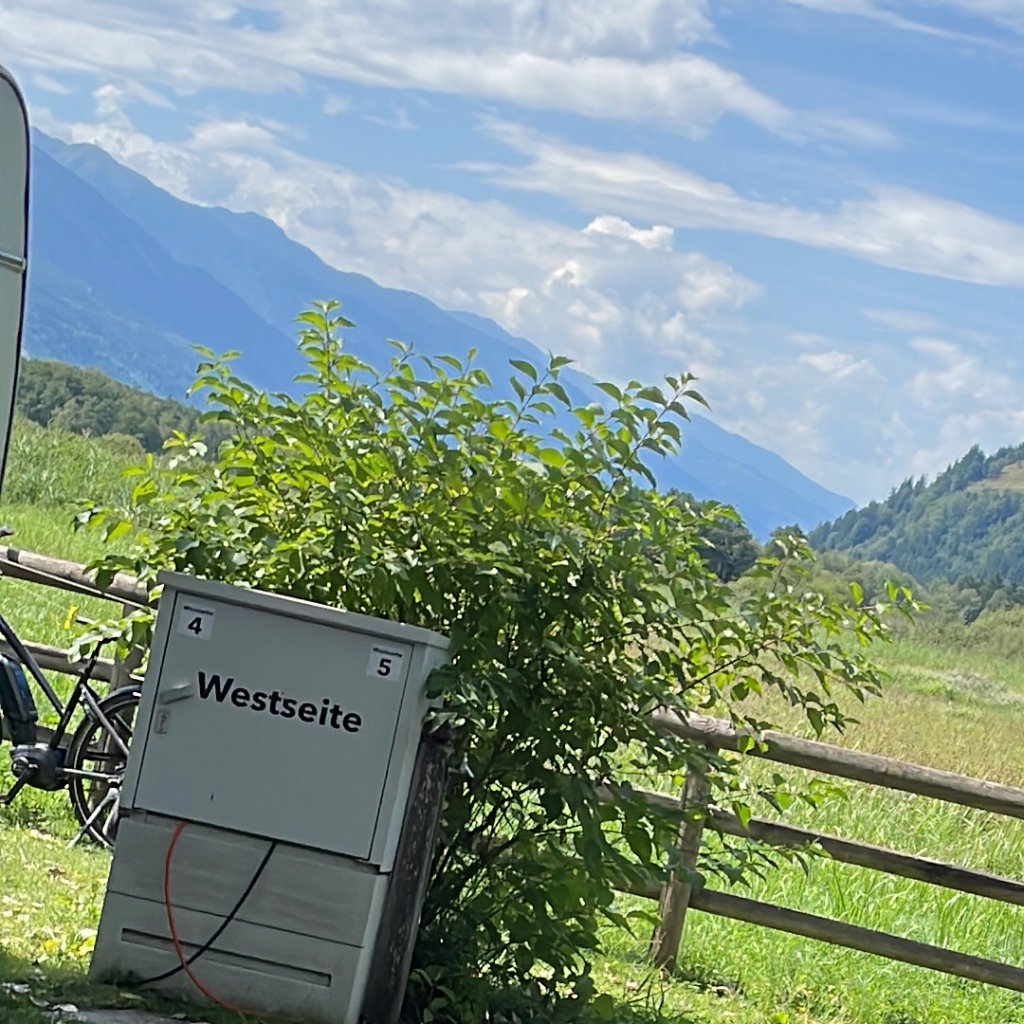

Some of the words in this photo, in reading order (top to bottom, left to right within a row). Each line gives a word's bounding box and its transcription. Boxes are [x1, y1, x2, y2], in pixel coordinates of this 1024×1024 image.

[187, 616, 202, 635] 4
[377, 658, 392, 677] 5
[198, 671, 362, 733] Westseite
